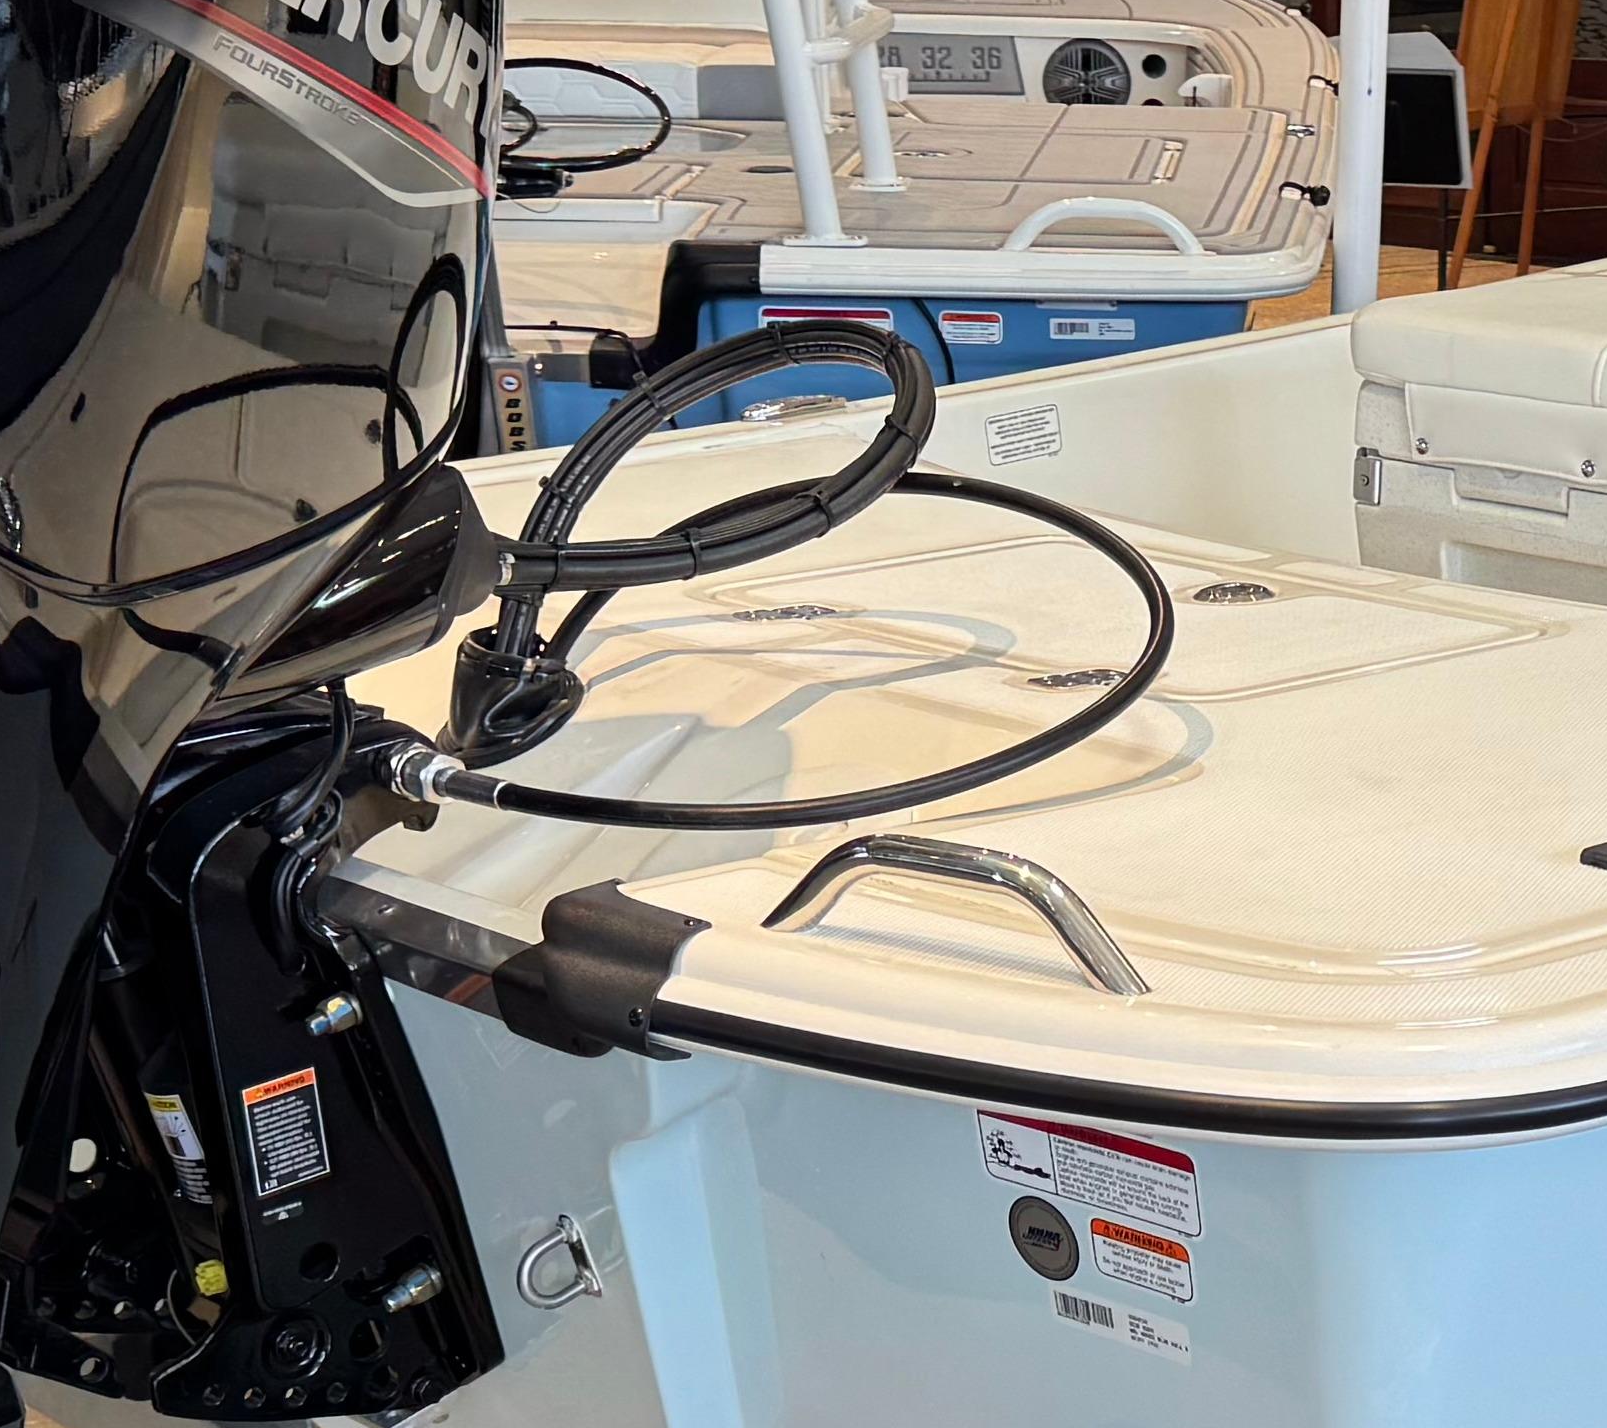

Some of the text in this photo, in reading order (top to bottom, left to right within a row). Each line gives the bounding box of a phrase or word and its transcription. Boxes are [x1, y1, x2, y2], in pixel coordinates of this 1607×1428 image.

[921, 46, 953, 70] 32
[971, 46, 1002, 70] 36
[212, 33, 363, 126] FOURSTROKE
[263, 1075, 306, 1097] WARNING
